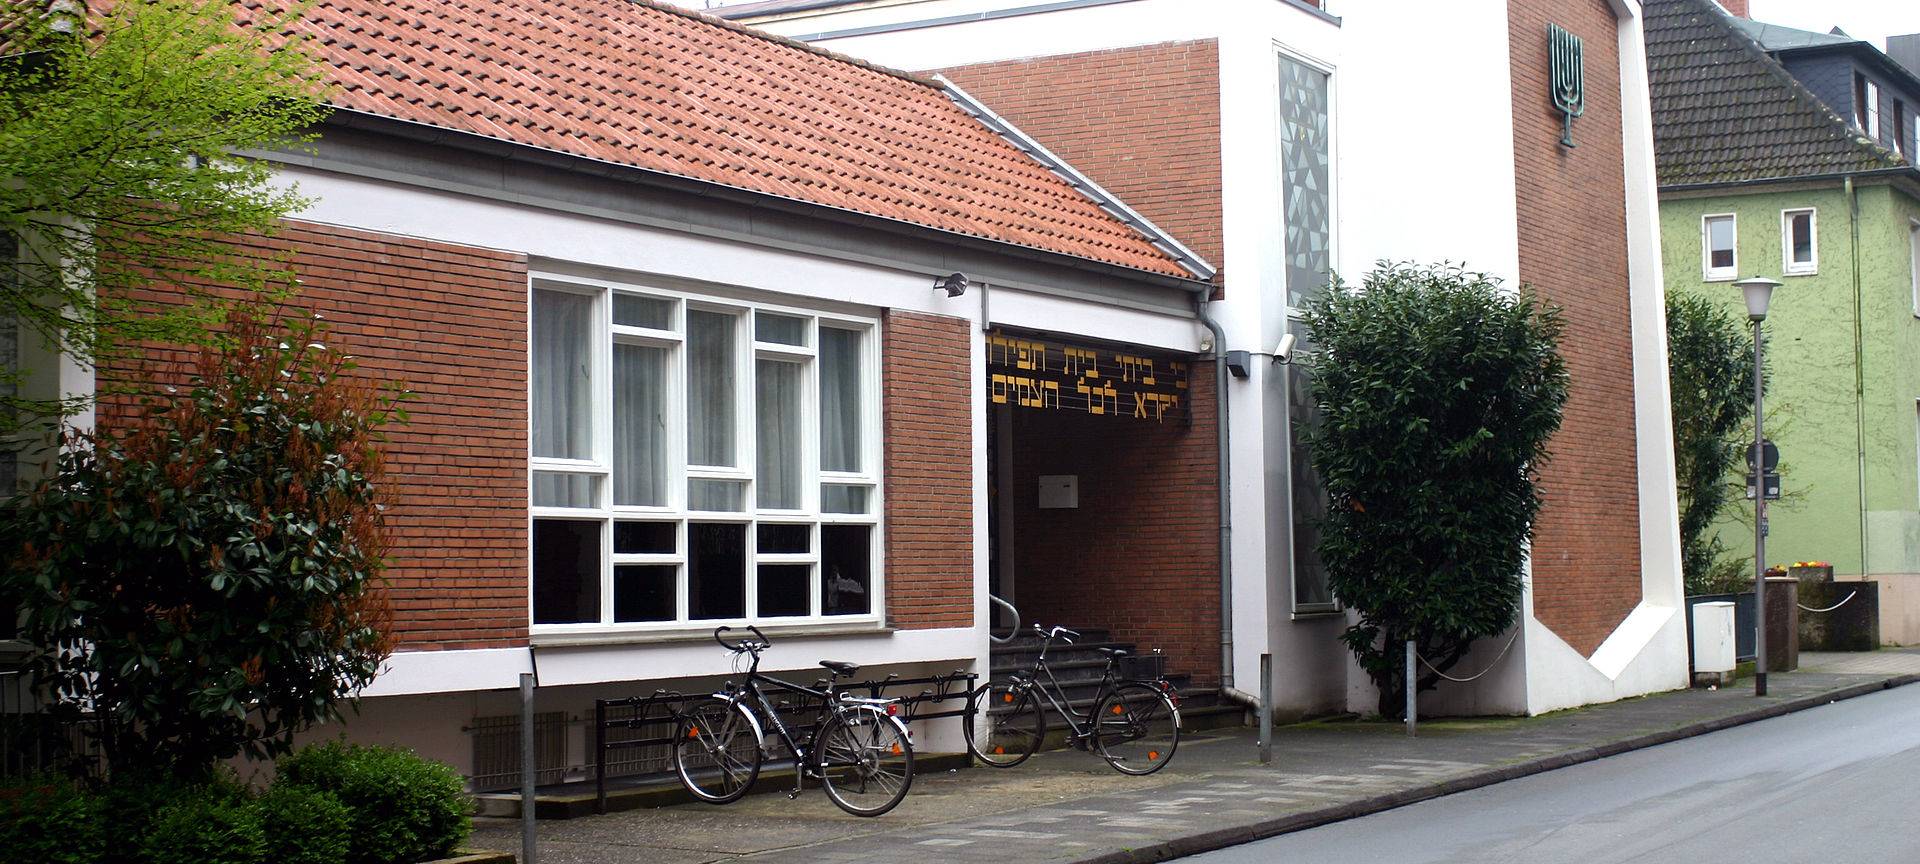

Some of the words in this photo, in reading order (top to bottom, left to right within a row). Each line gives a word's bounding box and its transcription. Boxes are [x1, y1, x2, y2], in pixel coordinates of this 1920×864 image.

[1063, 346, 1099, 379] בית
[1115, 354, 1156, 386] ביתי
[1169, 361, 1188, 389] כי
[992, 373, 1059, 410] העמים
[1077, 376, 1118, 416] לכל
[1134, 391, 1178, 424] יקרא
